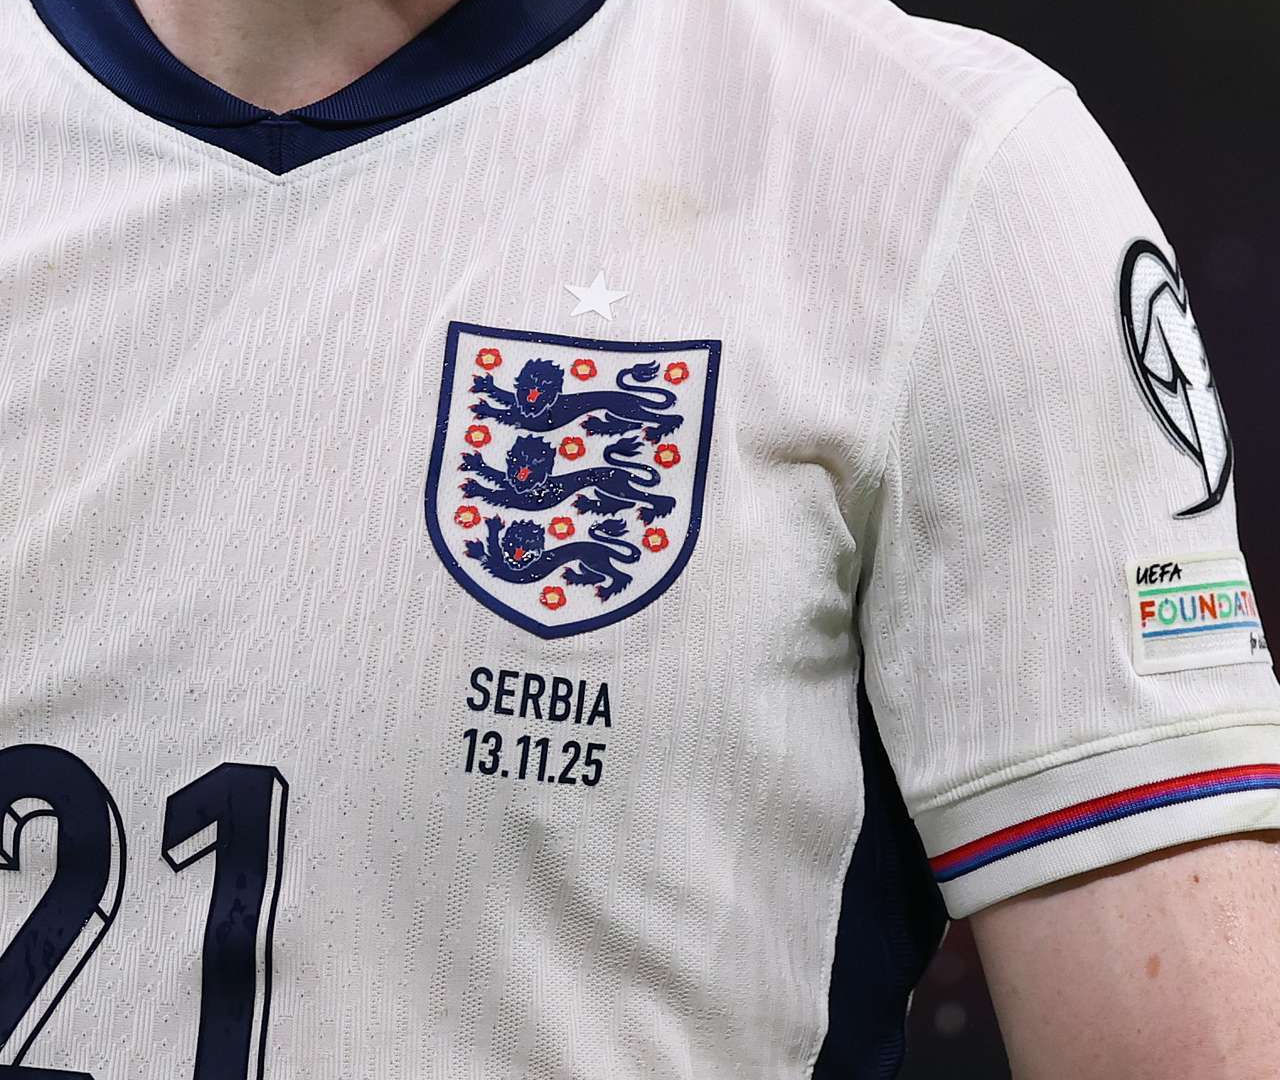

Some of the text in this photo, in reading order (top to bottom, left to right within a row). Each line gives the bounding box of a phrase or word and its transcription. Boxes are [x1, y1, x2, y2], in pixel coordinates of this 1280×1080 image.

[1136, 562, 1182, 584] UEFA
[466, 666, 612, 727] SERBIA
[463, 728, 606, 787] 13.11.25
